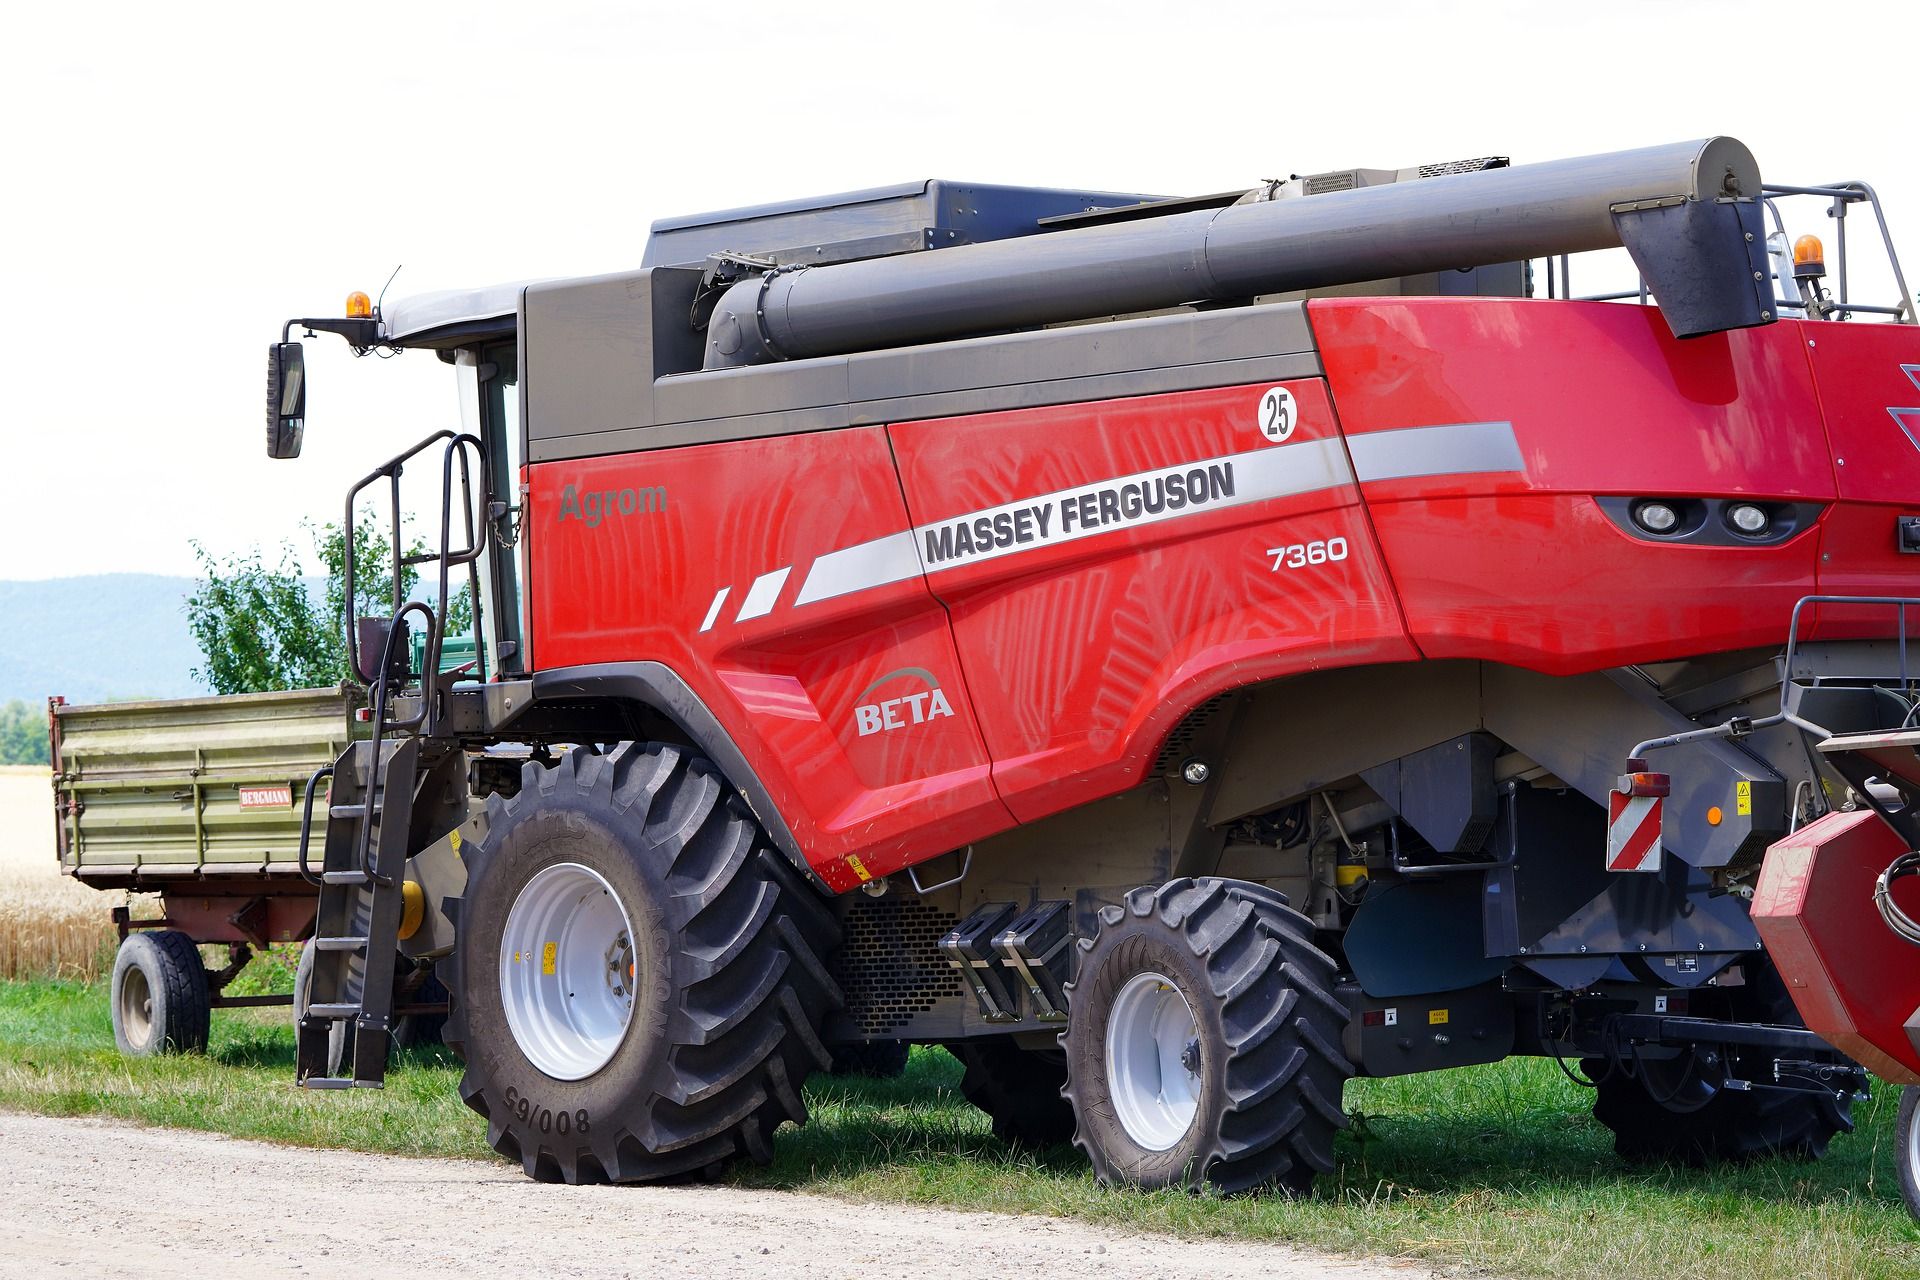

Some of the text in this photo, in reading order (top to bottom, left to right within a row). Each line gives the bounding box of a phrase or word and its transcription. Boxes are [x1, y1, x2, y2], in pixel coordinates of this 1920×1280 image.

[1266, 394, 1289, 436] 25
[557, 484, 667, 528] Agrom
[924, 461, 1236, 564] MASSEY FERGUSON
[1266, 537, 1348, 572] 7360
[854, 688, 955, 736] BETA
[241, 790, 289, 805] BERGMANN
[503, 1086, 591, 1135] 800/65
